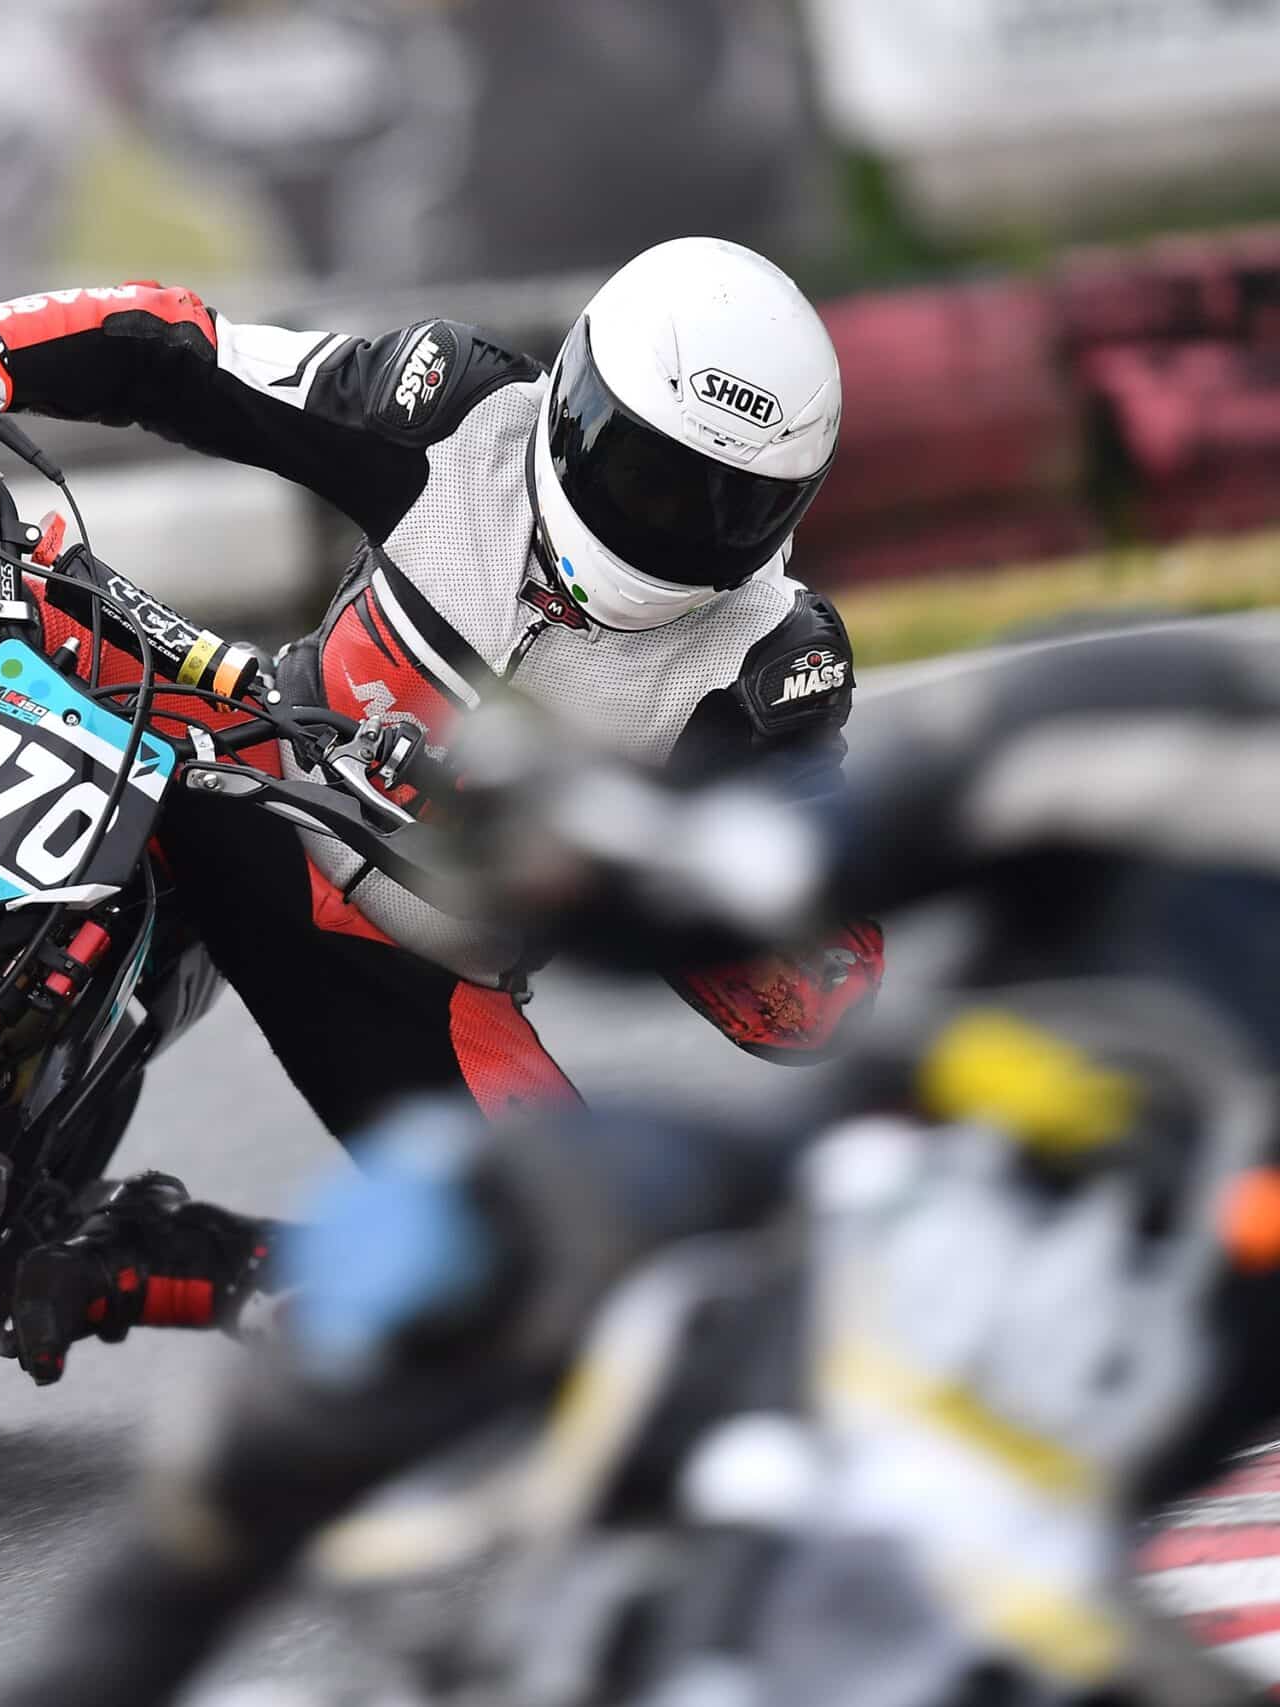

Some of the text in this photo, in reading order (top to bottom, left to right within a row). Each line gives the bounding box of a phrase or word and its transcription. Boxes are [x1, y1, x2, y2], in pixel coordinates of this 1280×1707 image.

[395, 332, 440, 421] MASS
[701, 374, 774, 423] SHOEI
[548, 602, 563, 616] M
[770, 661, 848, 706] MASS
